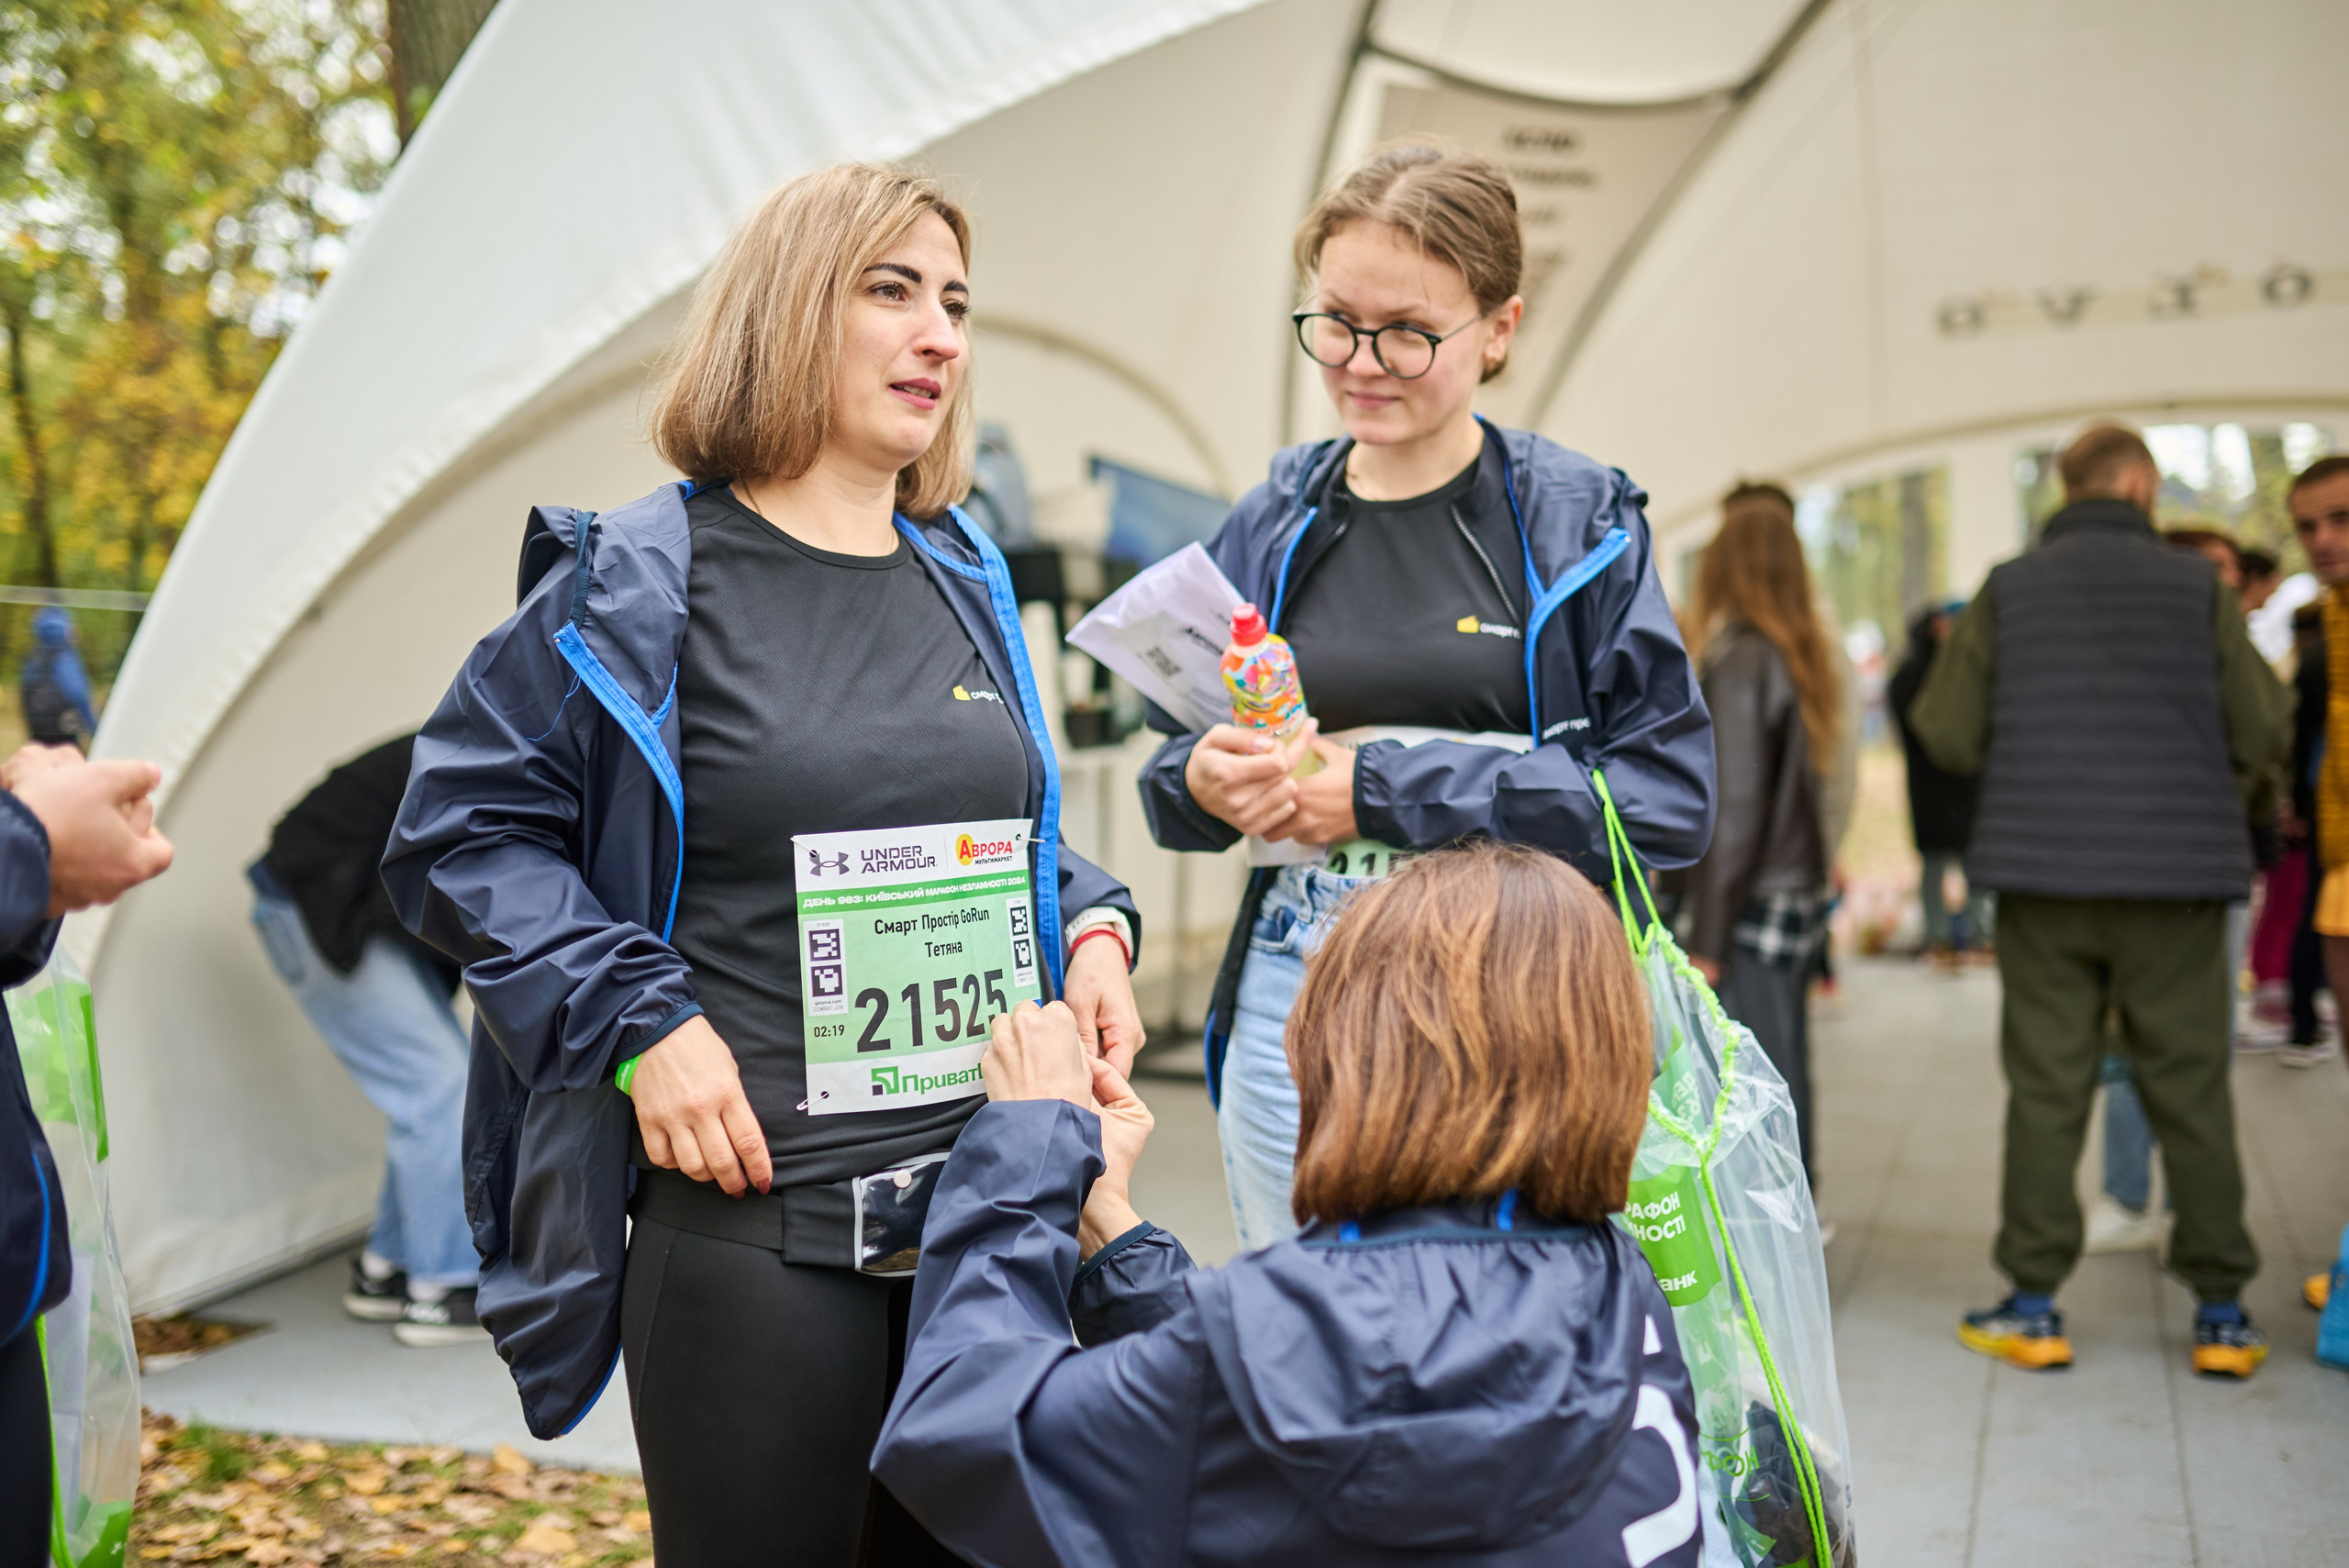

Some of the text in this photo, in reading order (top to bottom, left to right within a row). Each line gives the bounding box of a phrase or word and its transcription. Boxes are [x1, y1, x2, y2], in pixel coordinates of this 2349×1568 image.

[861, 845, 923, 862] UNDER
[959, 839, 1013, 860] АВРОРА
[861, 855, 936, 874] ARMOUR
[974, 855, 1013, 865] МУЛЬТИМАРКЕТ
[803, 875, 1026, 909] ДЕНЬ 963: КИЇВСЬКИЙ МАРАФОН НЕЗЛАМНОСТІ 2024
[874, 906, 989, 936] Смарт Простір GoRun
[925, 939, 963, 958] Тетяна
[854, 969, 1008, 1053] 21525
[814, 1025, 845, 1038] 02:19
[1653, 1270, 1698, 1292] анк
